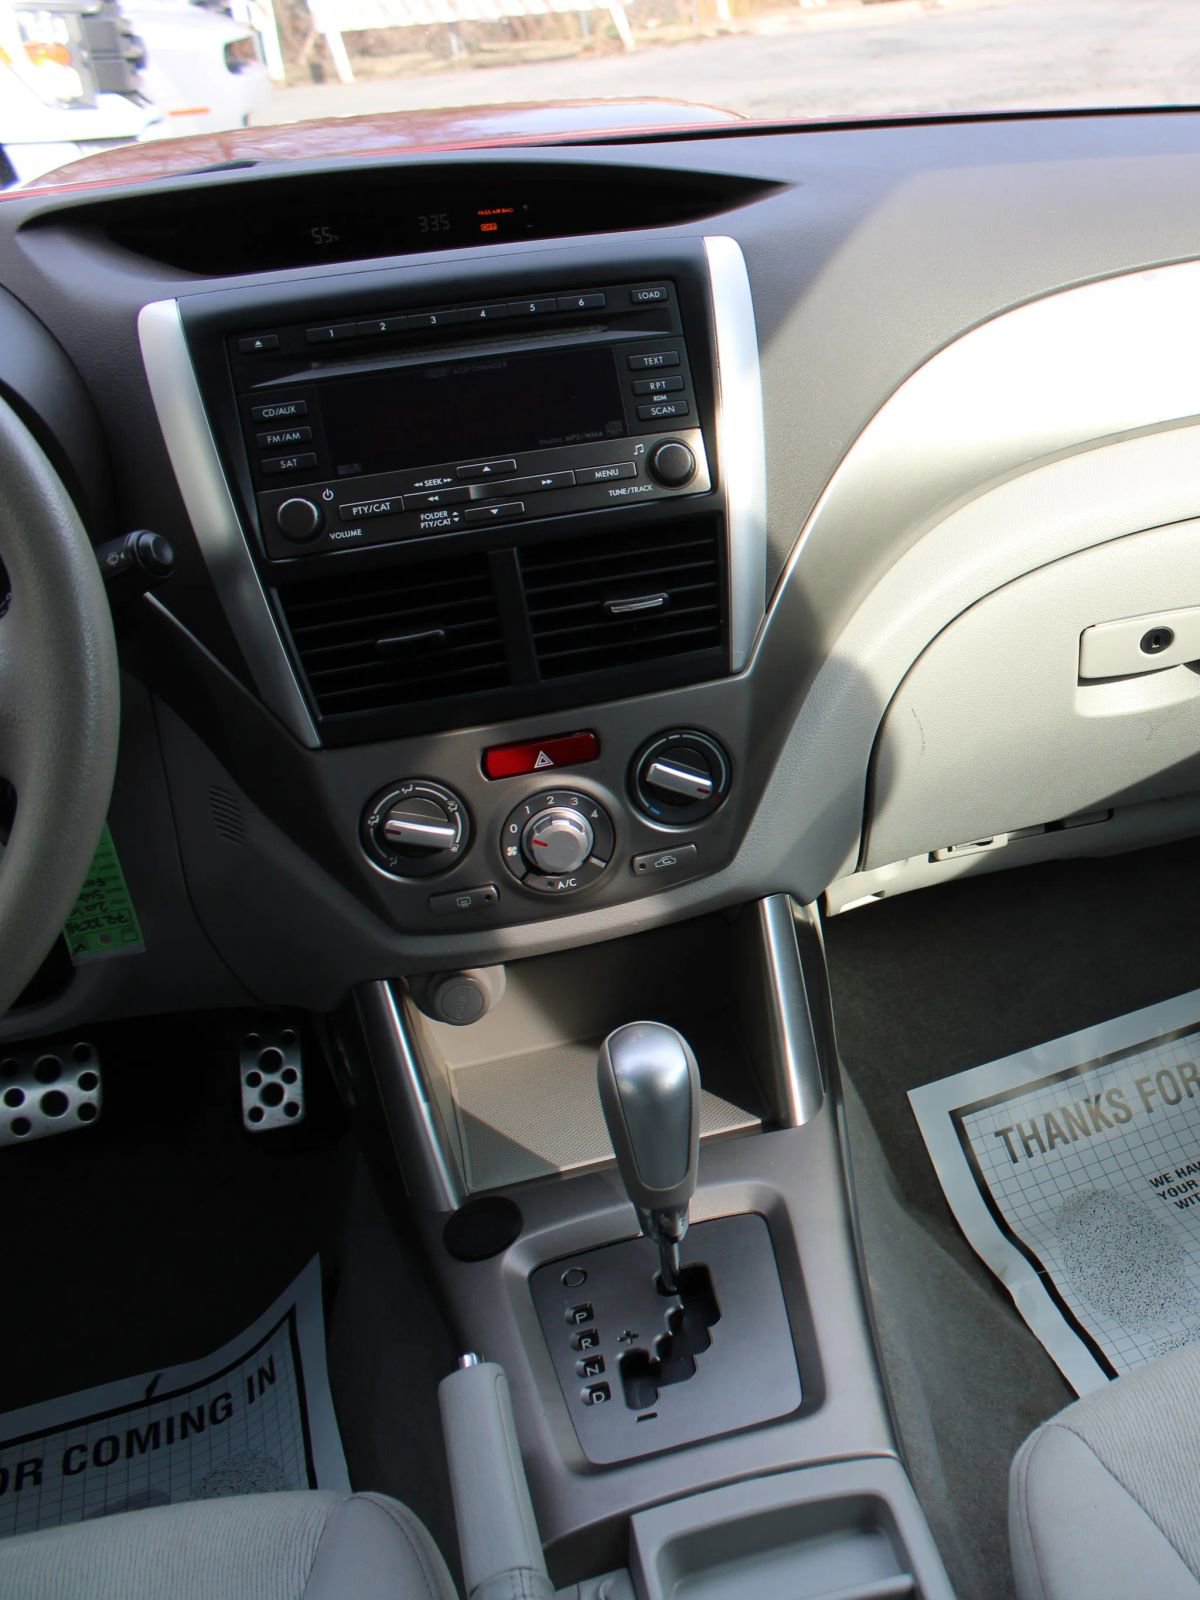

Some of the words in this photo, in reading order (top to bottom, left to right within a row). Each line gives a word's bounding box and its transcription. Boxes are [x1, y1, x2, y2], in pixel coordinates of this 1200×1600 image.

[639, 290, 660, 300] LOAD
[643, 356, 664, 366] TEXT
[650, 381, 667, 390] RPT
[262, 405, 297, 417] CD/AUX
[651, 406, 676, 415] SCAN
[267, 432, 301, 444] FM/AM
[280, 459, 298, 469] SAT
[595, 468, 619, 478] MENU
[424, 478, 443, 487] SEEK
[608, 485, 653, 497] TUNE/TRACK
[352, 503, 391, 516] PTY/CAT
[420, 511, 449, 521] FOLDER
[420, 518, 452, 529] PTY/CAT
[329, 529, 363, 540] VOLUME
[547, 796, 555, 805] 2
[571, 797, 579, 806] 3
[524, 805, 531, 815] 1
[591, 809, 599, 819] 4
[556, 878, 577, 890] A/C
[994, 1088, 1133, 1164] THANKS
[1150, 1172, 1174, 1188] WE
[1157, 1180, 1198, 1201] YOUR
[575, 1312, 587, 1324] P
[581, 1338, 592, 1350] R
[586, 1364, 599, 1377] N
[592, 1391, 605, 1404] D
[62, 1391, 234, 1476] COMING
[247, 1354, 277, 1405] IN
